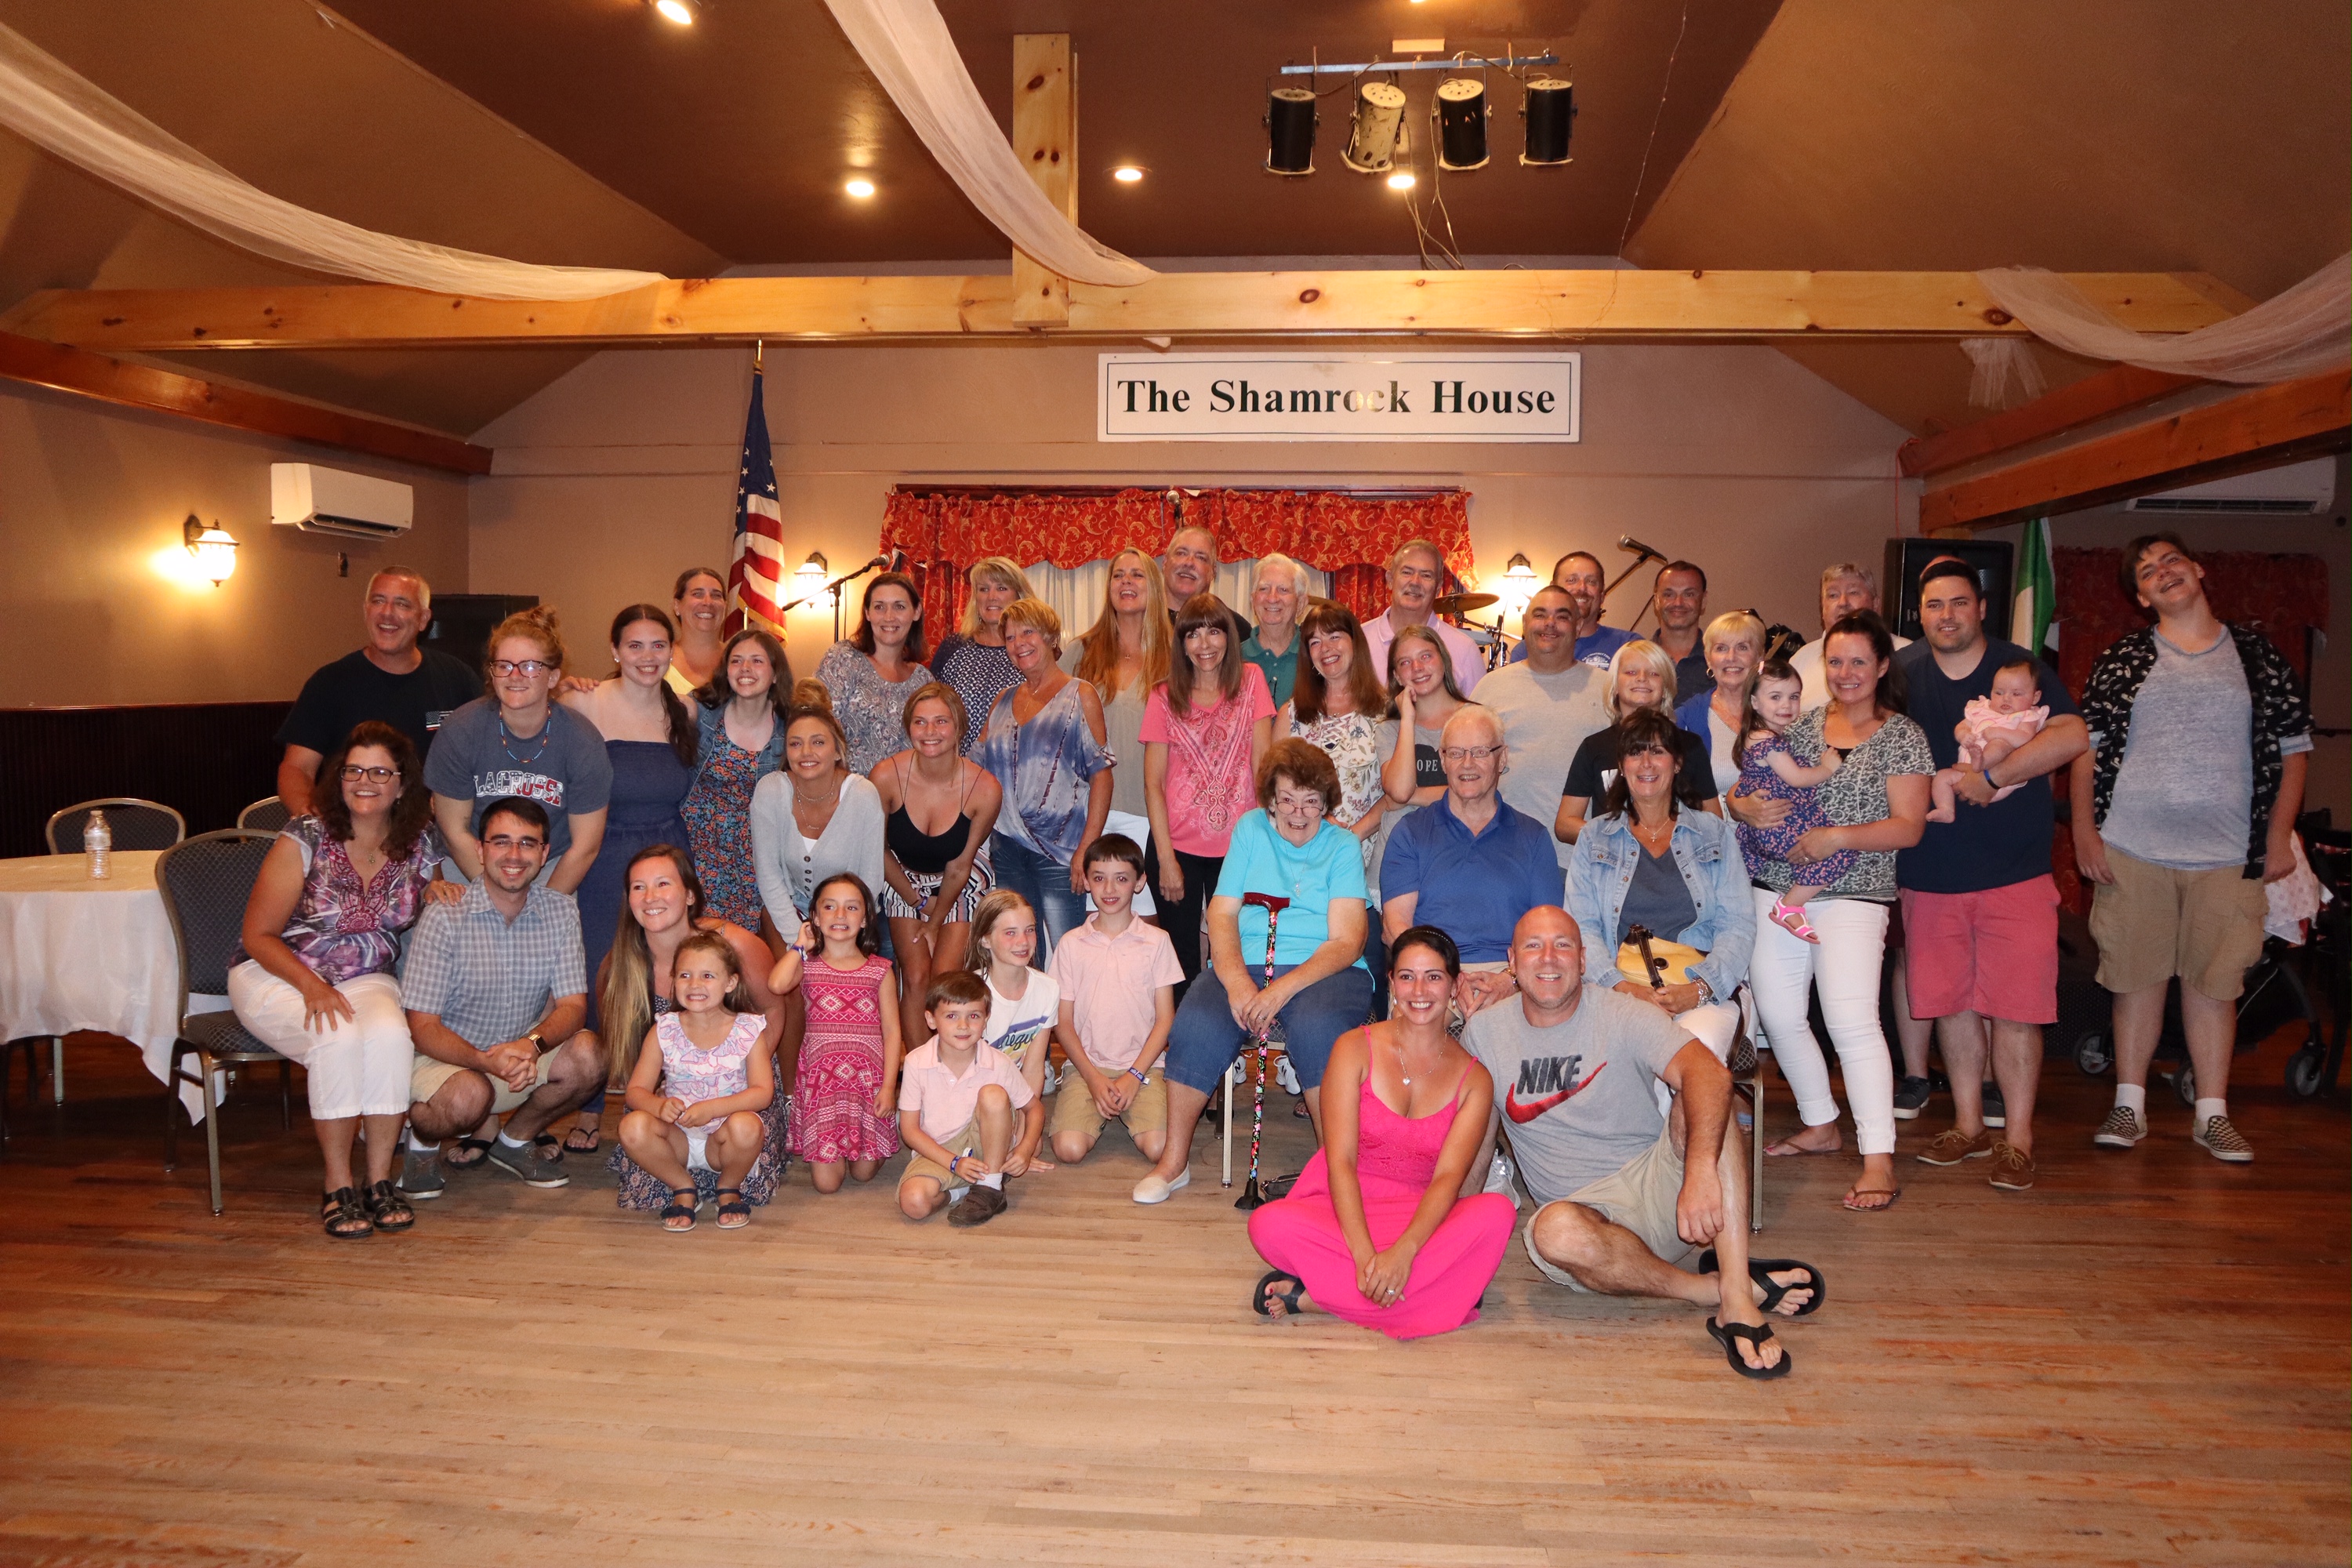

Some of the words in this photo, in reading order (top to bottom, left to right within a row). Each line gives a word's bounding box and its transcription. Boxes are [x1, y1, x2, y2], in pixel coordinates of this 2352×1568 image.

[1117, 380, 1190, 412] The
[1210, 379, 1411, 413] Shamrock
[1430, 380, 1555, 414] House
[473, 770, 564, 807] LACROSSE
[1515, 1054, 1582, 1094] NIKE
